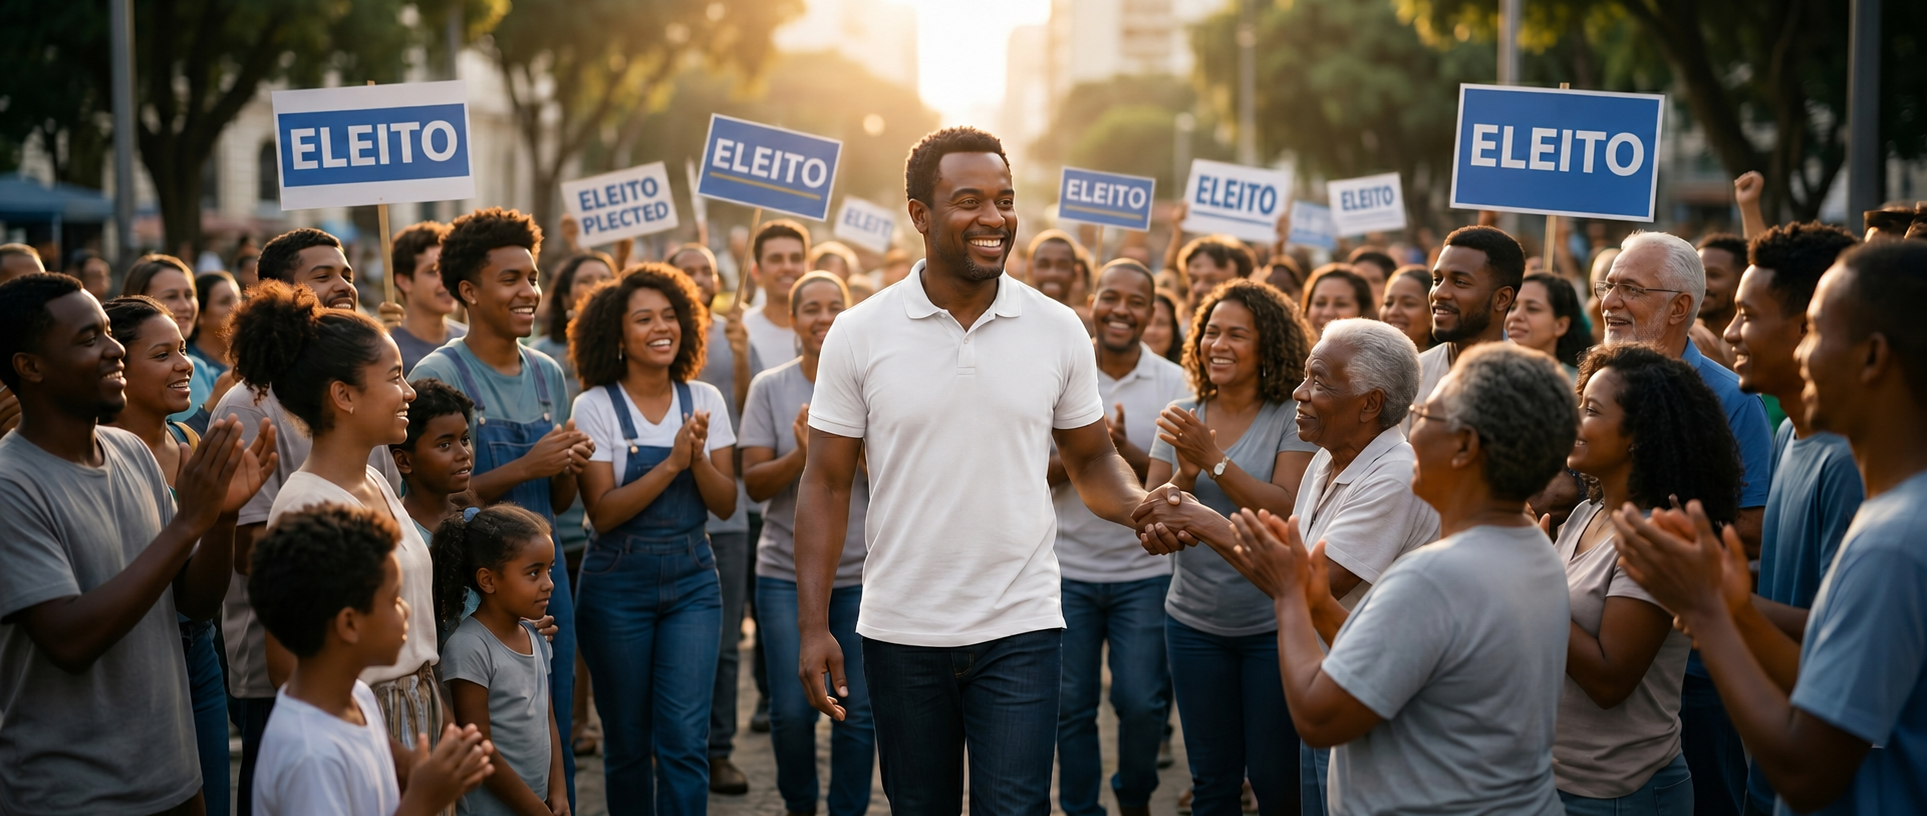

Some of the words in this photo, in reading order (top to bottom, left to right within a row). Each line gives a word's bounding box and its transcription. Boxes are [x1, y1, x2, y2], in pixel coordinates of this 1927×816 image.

[290, 120, 458, 170] ELEITO
[712, 138, 827, 188] ELEITO
[1470, 123, 1644, 177] ELEITO
[578, 176, 658, 211] ELEITO
[1066, 179, 1146, 210] ELEITO
[1195, 174, 1277, 215] ELEITO
[1341, 185, 1394, 211] ELEITO
[582, 201, 669, 235] PLECTED
